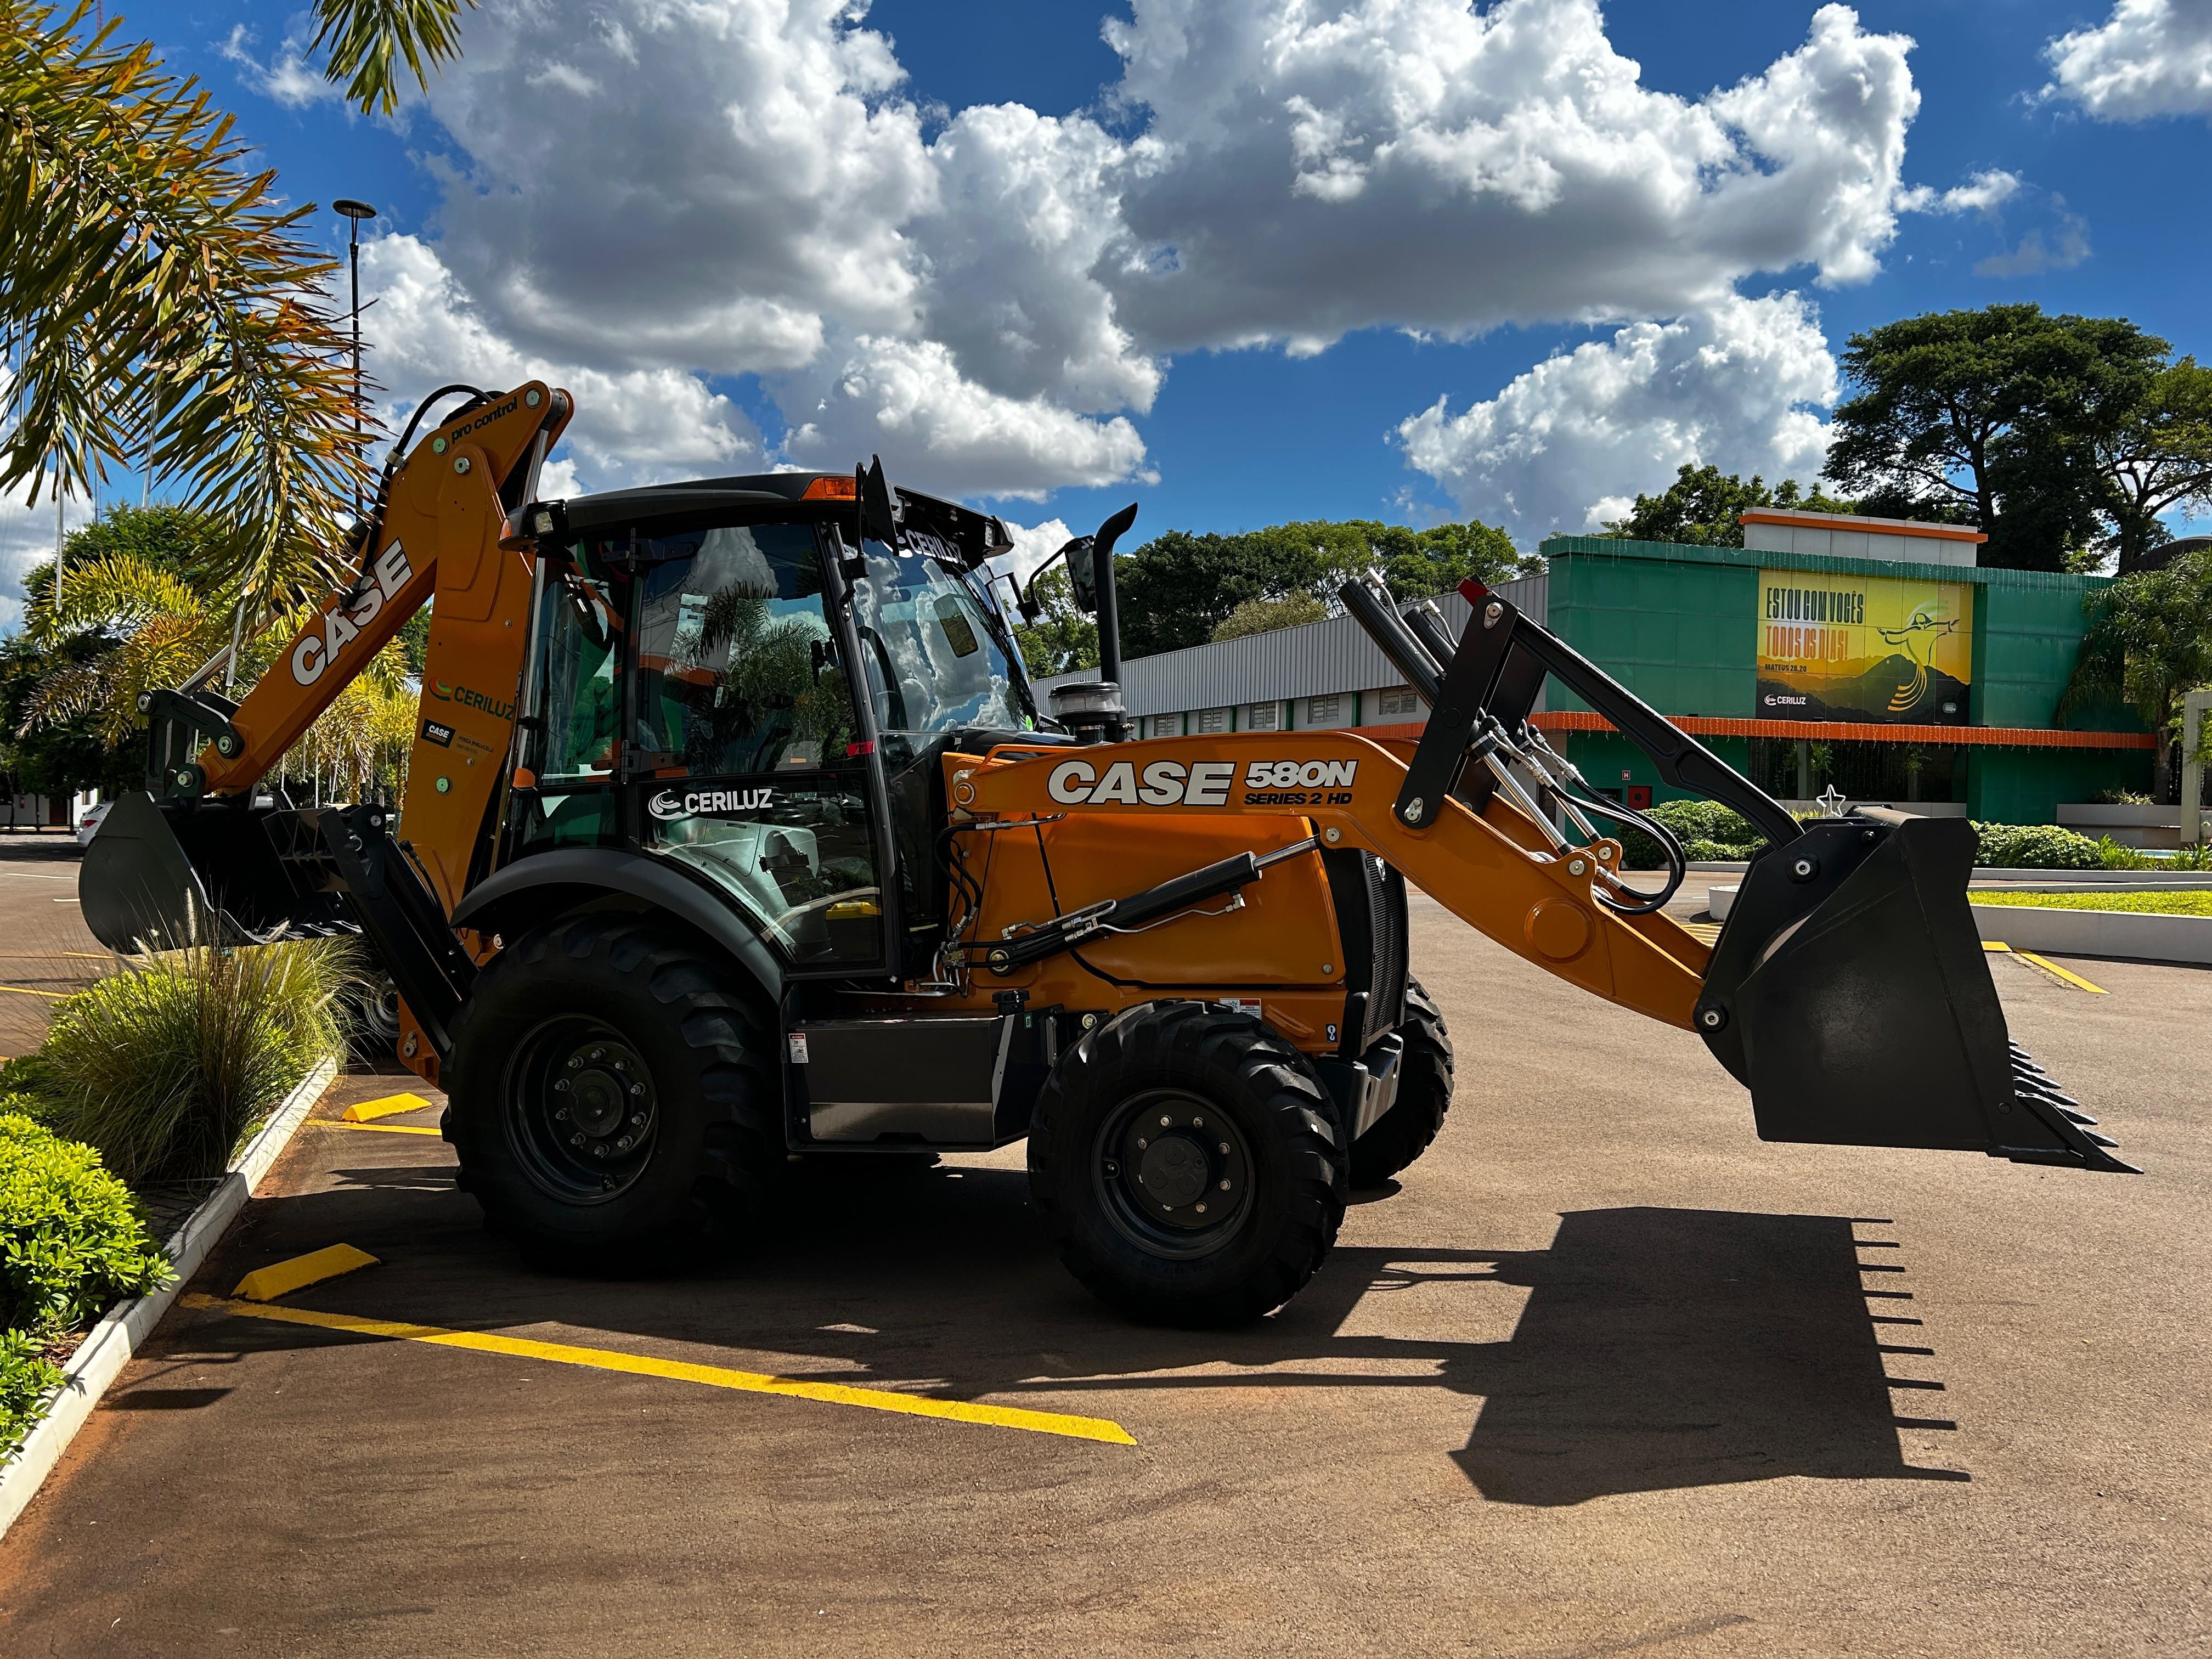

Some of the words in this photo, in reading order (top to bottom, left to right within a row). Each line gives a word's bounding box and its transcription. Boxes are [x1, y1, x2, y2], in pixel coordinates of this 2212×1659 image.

[452, 424, 471, 445] pro
[474, 396, 518, 430] control
[291, 537, 414, 686] CASE
[1767, 588, 1801, 620] ESTOU
[1803, 590, 1827, 621] COM
[1830, 590, 1863, 624] VOCÊS
[1766, 625, 1801, 658] TODOS
[1804, 628, 1816, 659] OS
[1819, 629, 1848, 661] DIAS!
[454, 686, 516, 721] CERILUZ
[1777, 696, 1806, 705] CERILUZ
[428, 725, 450, 738] CASE
[1047, 759, 1237, 806] CASE
[1244, 759, 1359, 789] 580N
[1244, 793, 1307, 805] SERIES
[1308, 793, 1323, 805] 2
[1327, 793, 1352, 805] HD
[685, 789, 773, 812] CERILUZ
